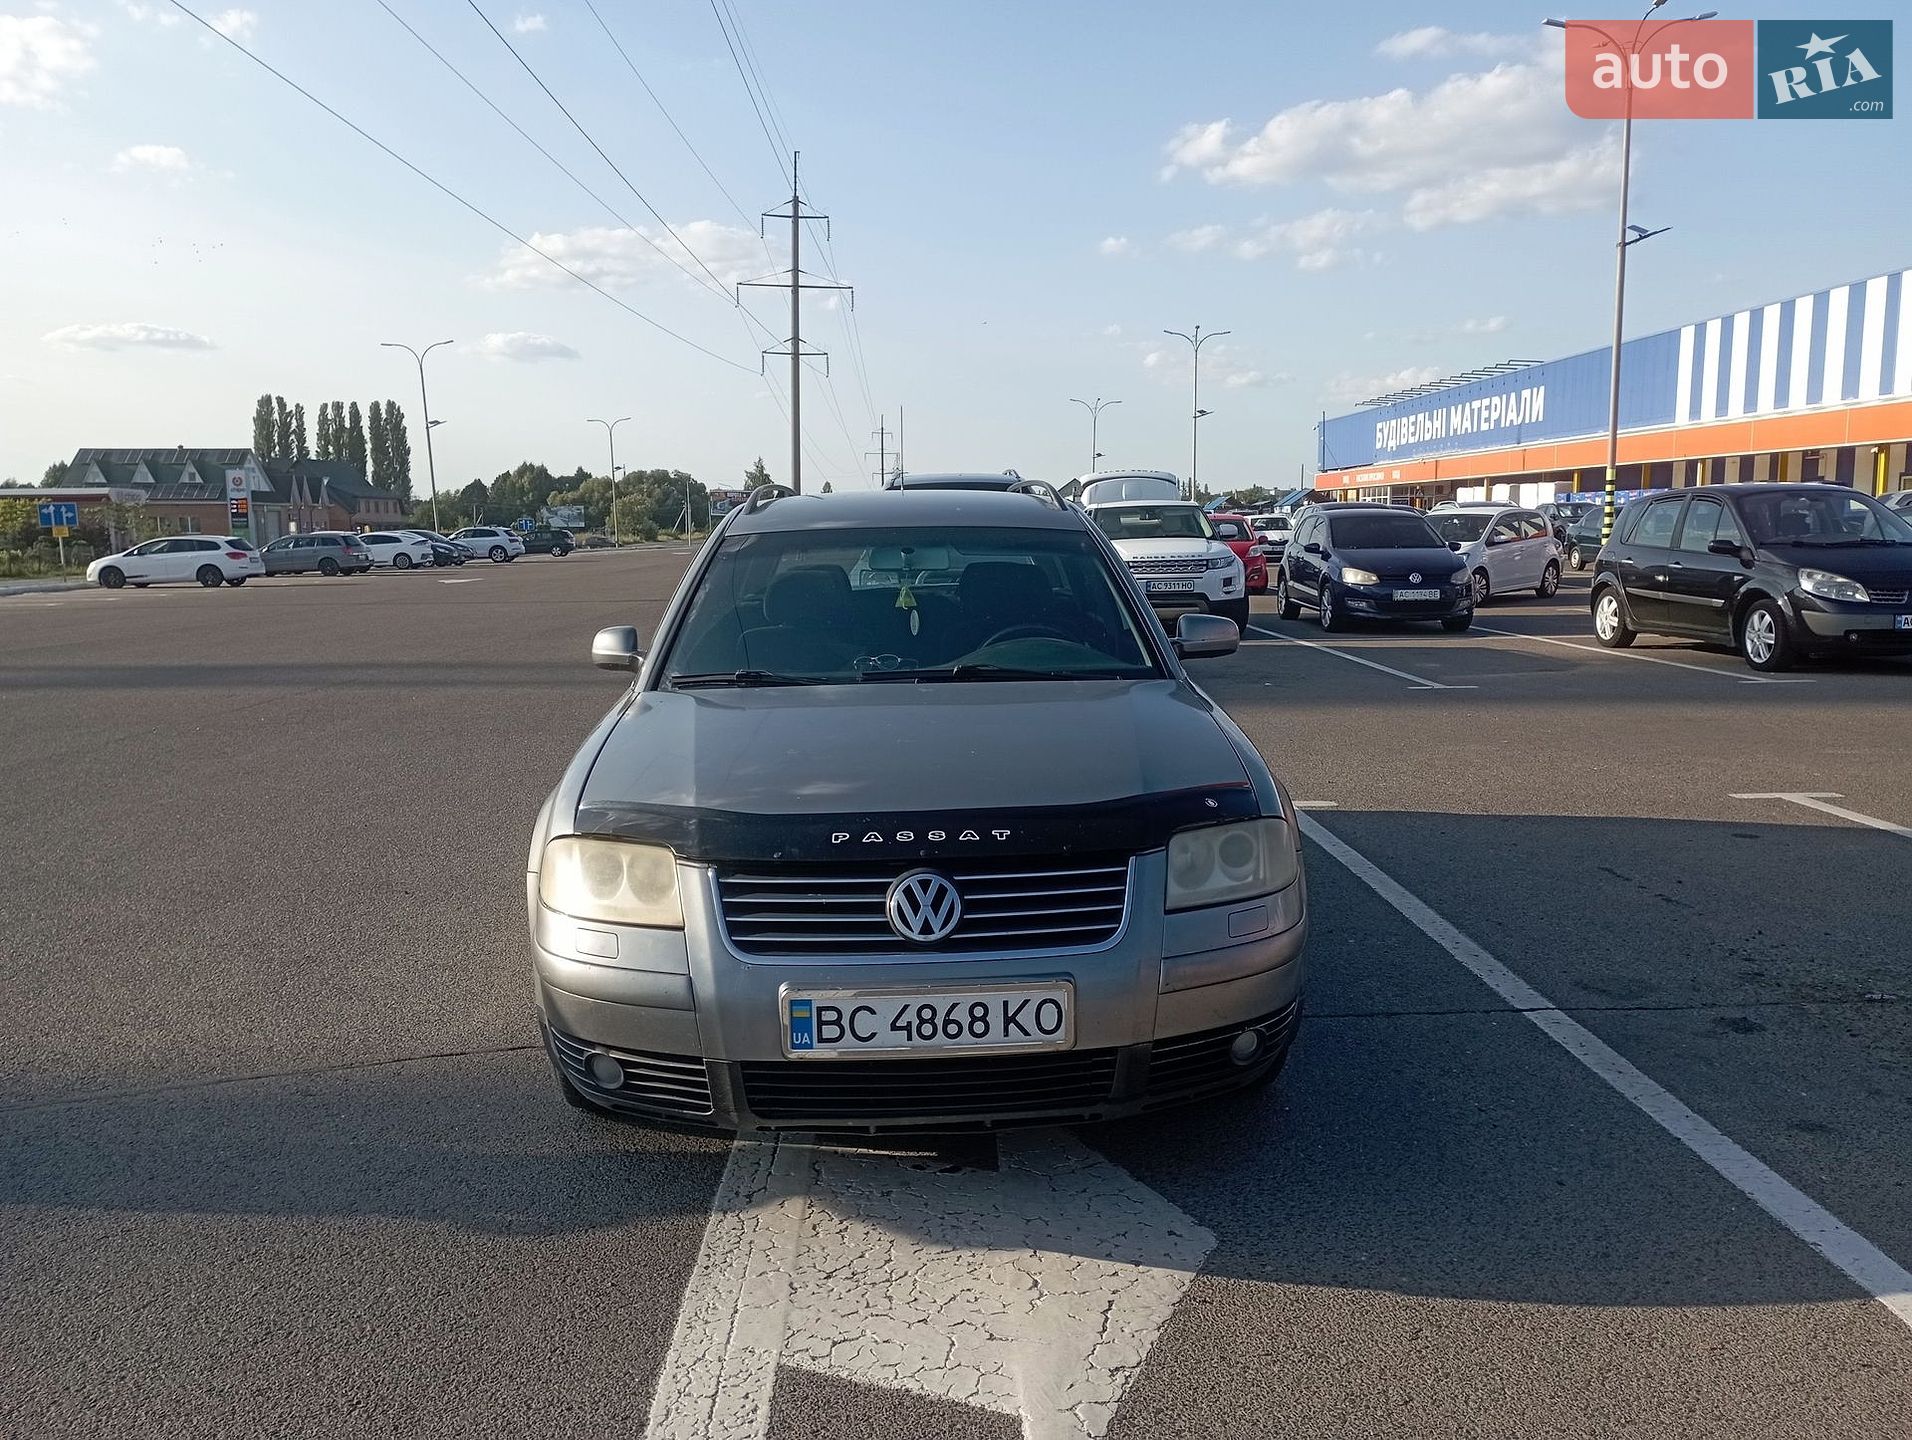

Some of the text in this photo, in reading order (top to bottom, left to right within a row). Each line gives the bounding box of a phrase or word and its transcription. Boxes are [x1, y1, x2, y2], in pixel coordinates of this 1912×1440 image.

[1375, 385, 1546, 452] БУДІВЕЛЬНІ МАТЕРІАЛИ
[1151, 582, 1163, 590] AC
[1164, 582, 1180, 590] 9311
[831, 829, 1011, 844] PASSAT
[815, 997, 1064, 1045] BC 4868 KO
[792, 1032, 811, 1045] UA
